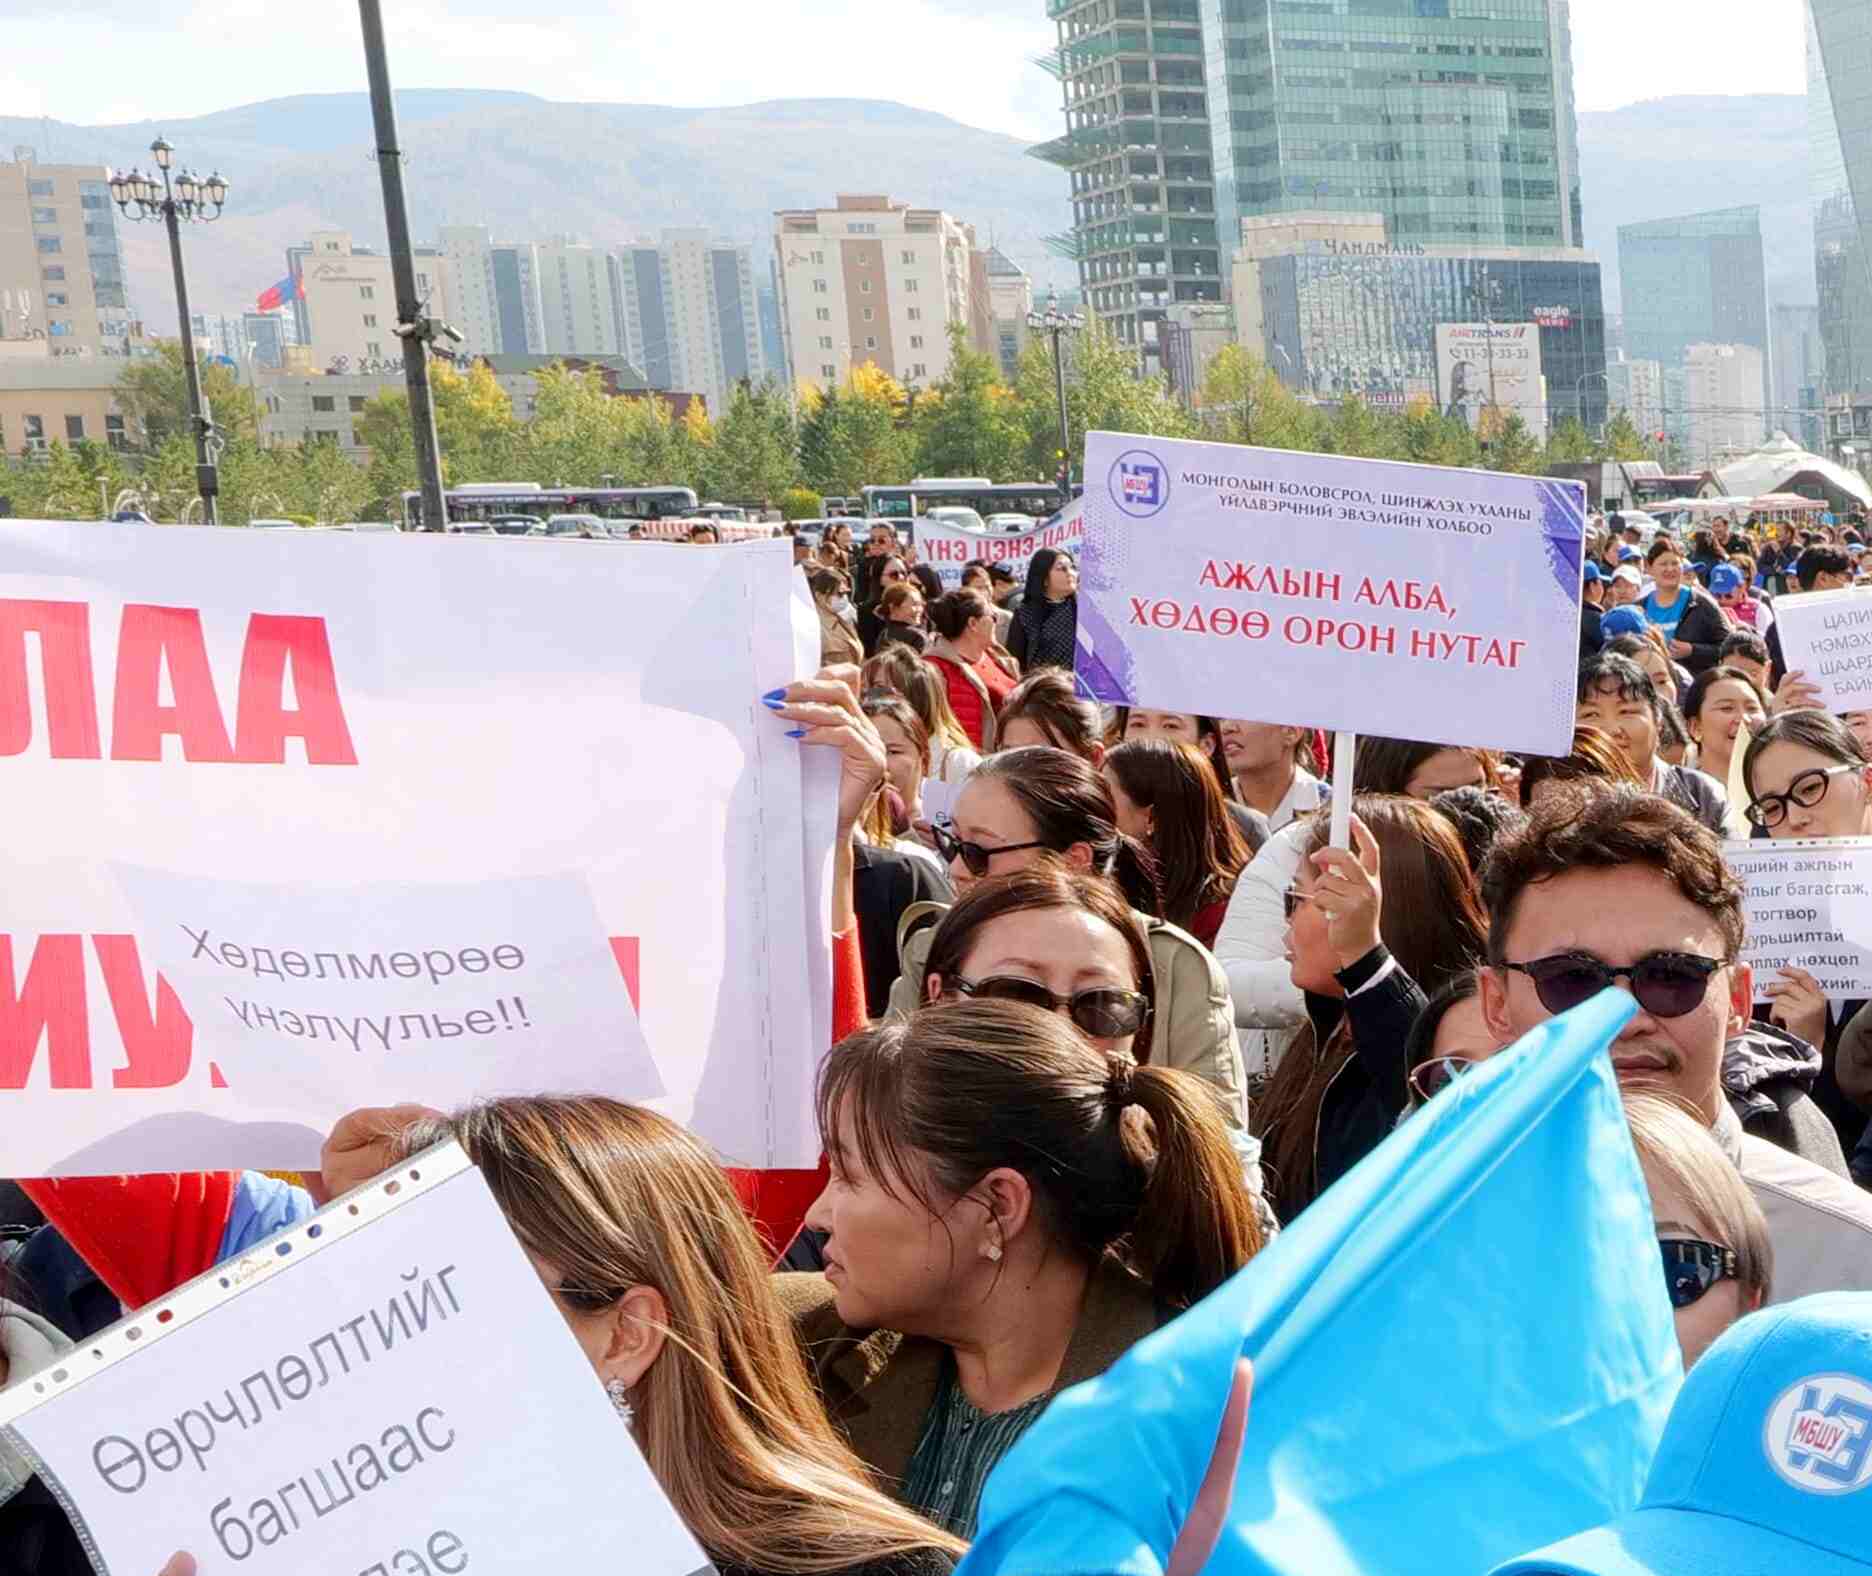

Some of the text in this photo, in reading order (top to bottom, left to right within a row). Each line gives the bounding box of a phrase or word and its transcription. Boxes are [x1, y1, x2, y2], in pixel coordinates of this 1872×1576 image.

[1181, 471, 1532, 521] МОНГОЛЫН БОЛОВСРОЛ, ШИНЖЛЭХ УХААНЫ
[1218, 494, 1493, 536] ҮЙЛДВЭРЧНИЙ ЭВЛЭЛИЙН ХОЛБОО
[923, 538, 968, 561] ҮНЭ
[1199, 559, 1457, 619] АЖЛЫН АЛБА,
[1129, 597, 1528, 668] ХӨДӨӨ ОРОН НУТАГ
[1793, 859, 1854, 874] ажлын
[1753, 907, 1818, 923] тогтвор
[181, 922, 527, 989] Хөдөлмөрөө
[223, 992, 530, 1053] үнэлүүлье!!
[93, 1262, 464, 1496] Өөрчлөлтийг
[1793, 1411, 1846, 1455] МБШУ
[210, 1402, 458, 1565] багшаас
